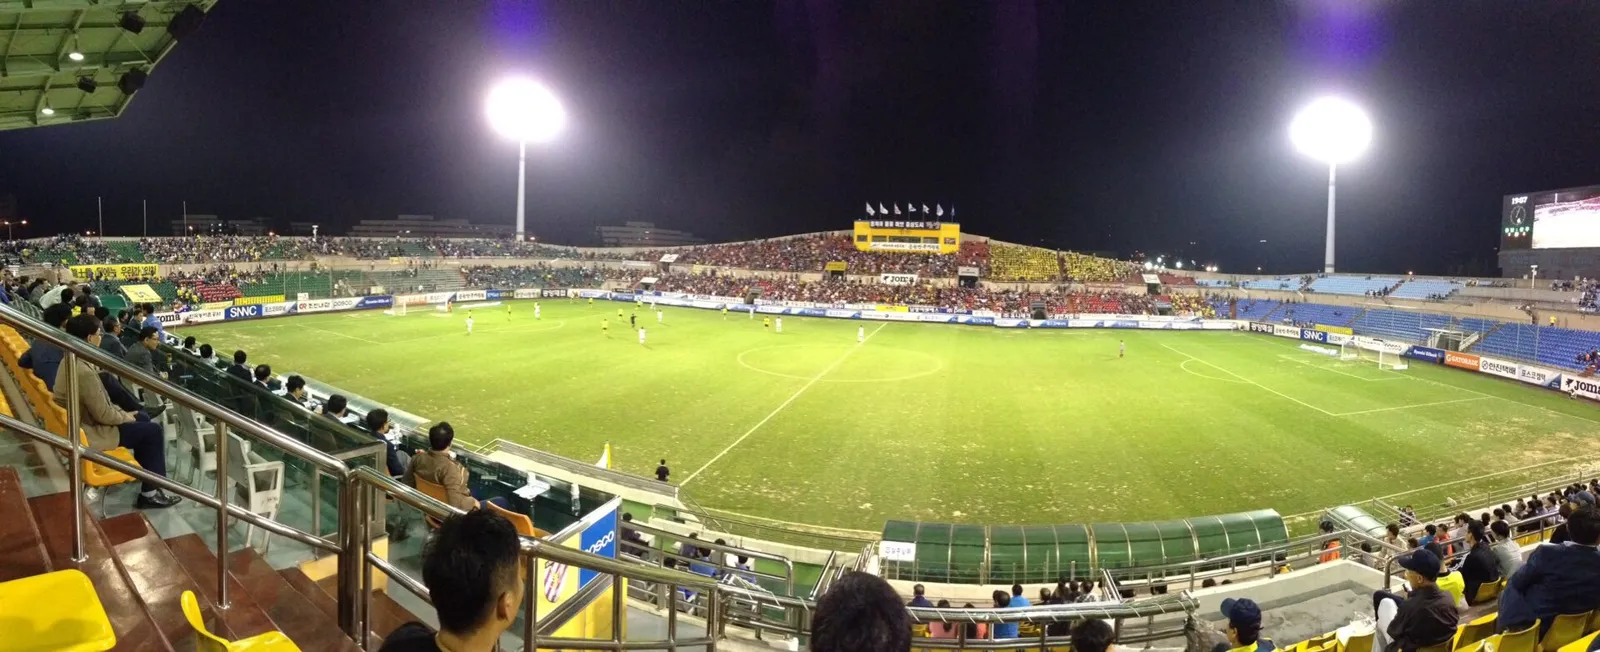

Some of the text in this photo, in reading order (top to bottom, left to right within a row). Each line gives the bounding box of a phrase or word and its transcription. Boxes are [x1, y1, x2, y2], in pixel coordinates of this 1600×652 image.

[230, 305, 257, 318] SNNC
[157, 313, 181, 323] oma
[1303, 330, 1323, 341] SNNC
[1488, 362, 1516, 375] 한진택배
